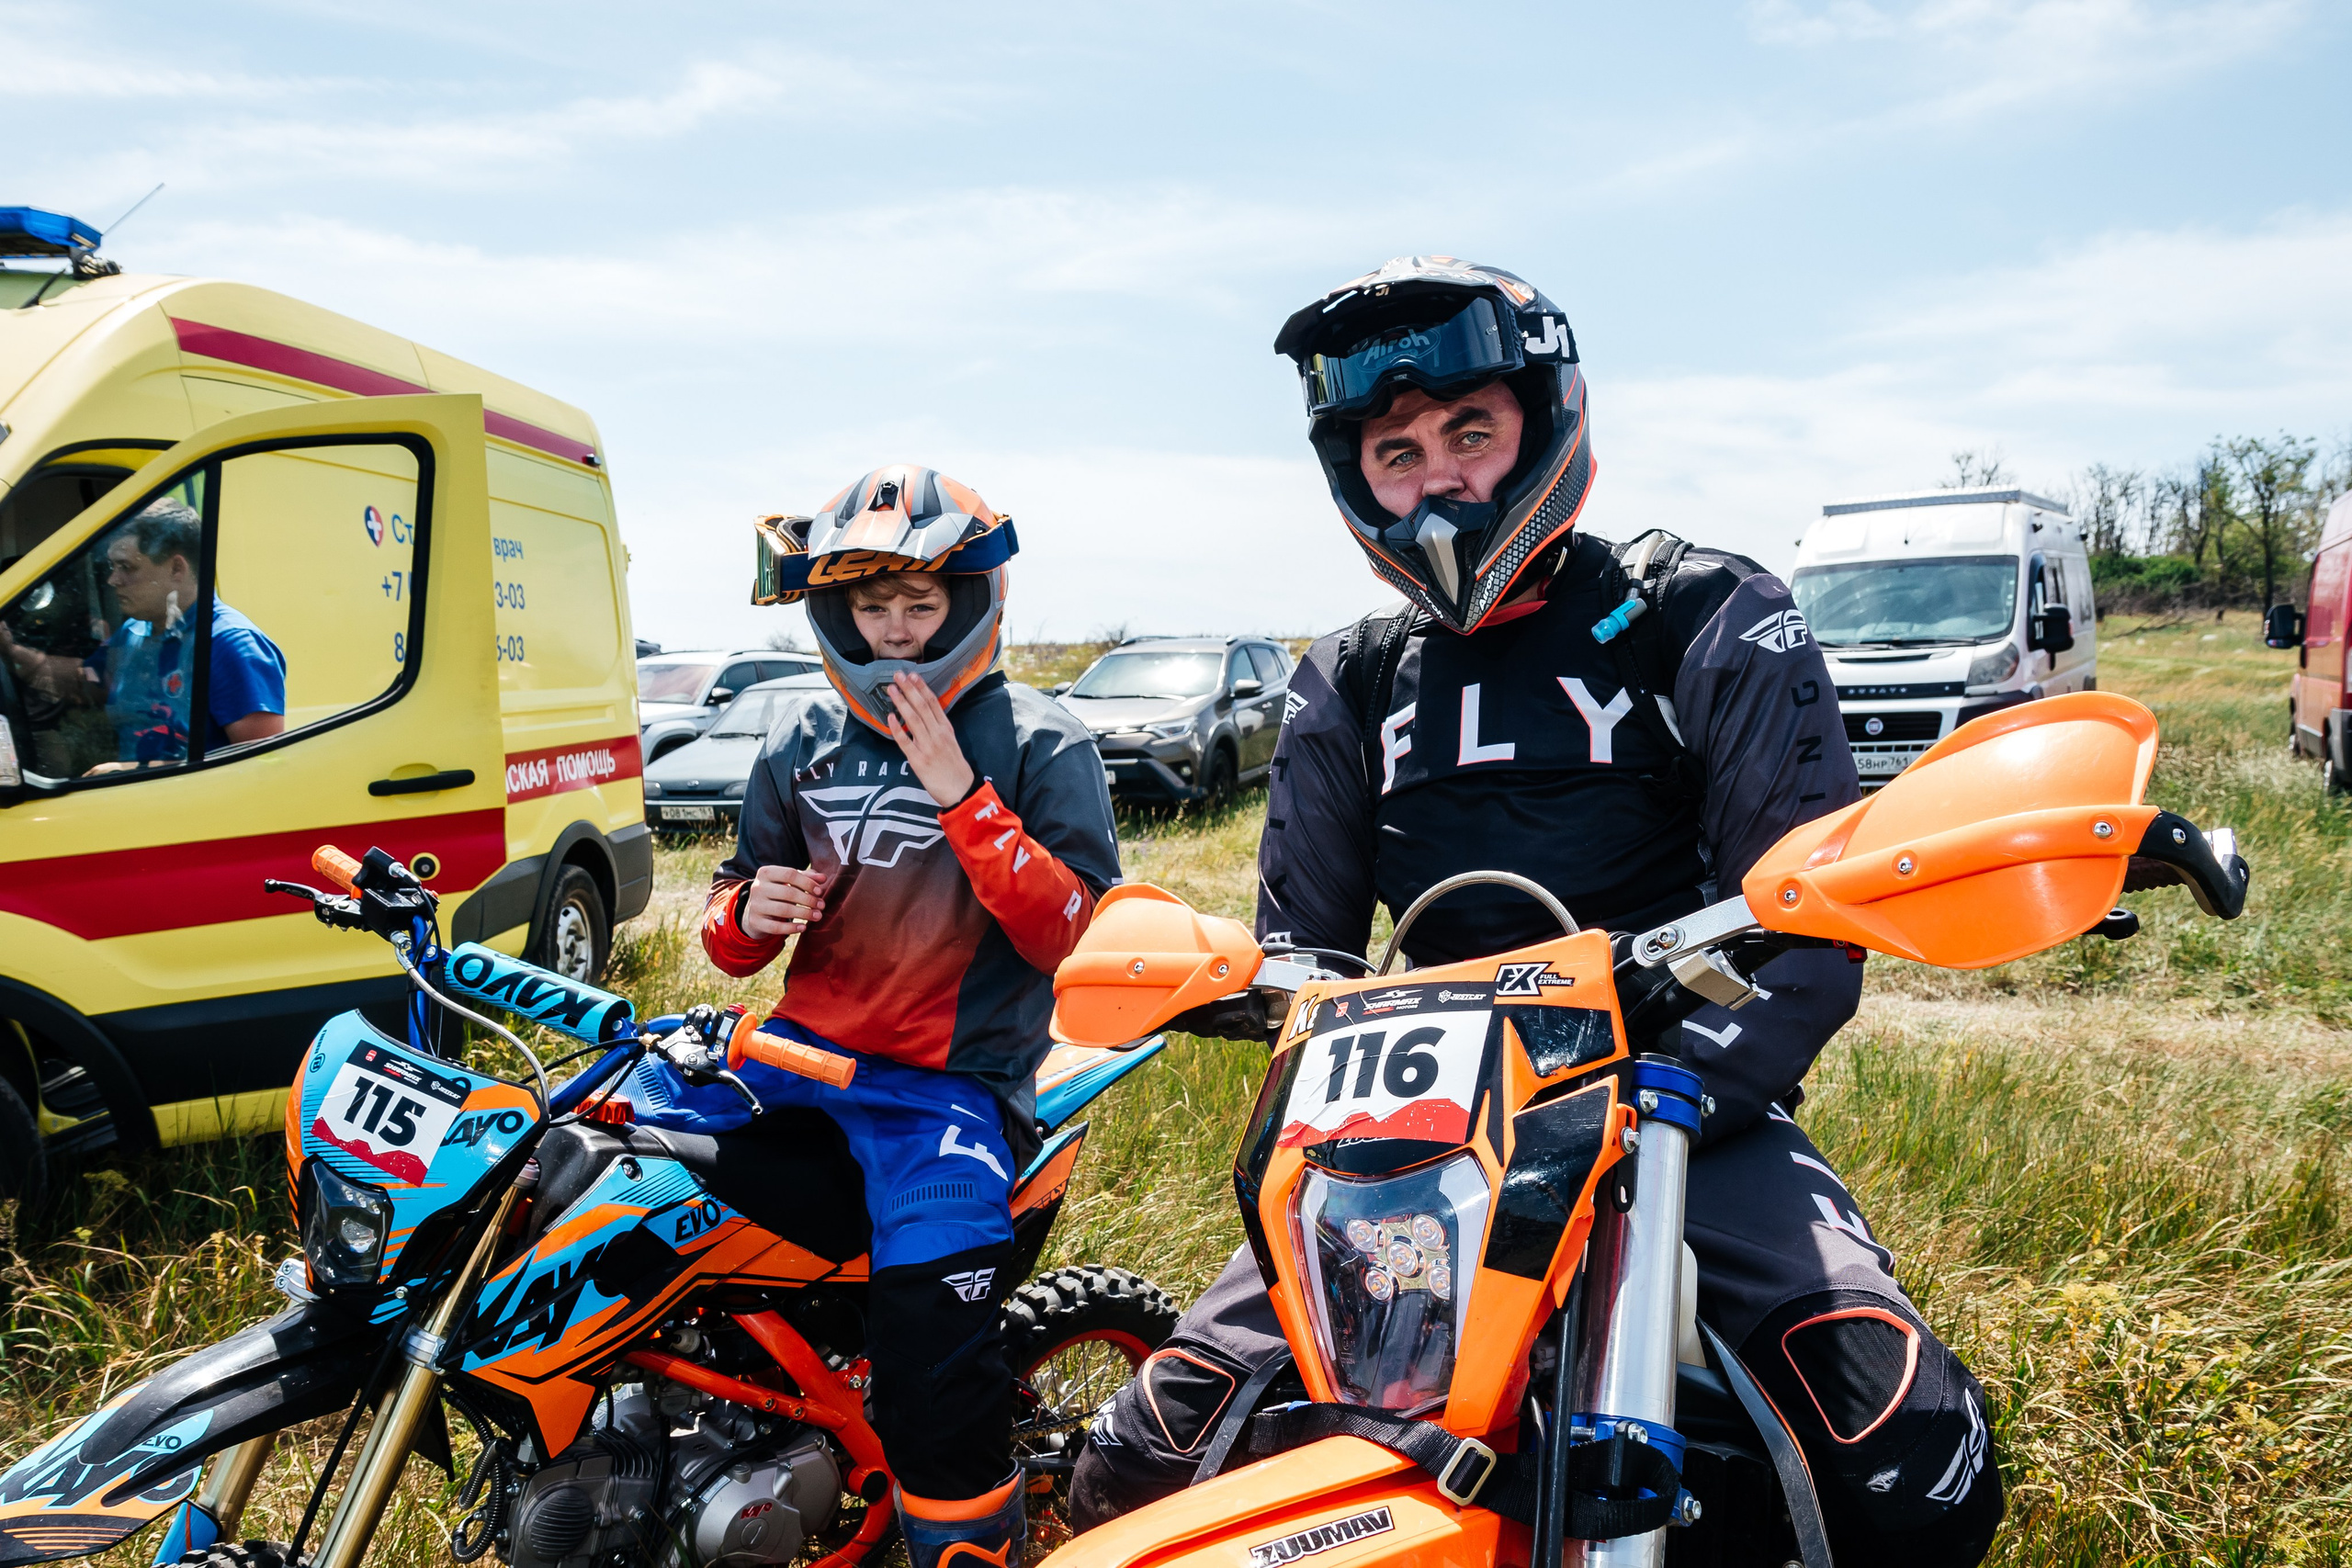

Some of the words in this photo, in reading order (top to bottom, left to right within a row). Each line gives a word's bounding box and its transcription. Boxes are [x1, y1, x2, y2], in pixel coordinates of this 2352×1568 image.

[391, 513, 413, 546] Ст
[492, 536, 525, 562] врач
[494, 581, 526, 610] 3-03
[1419, 589, 1444, 620] Airoh
[1477, 570, 1496, 614] Airoh
[1381, 677, 1634, 795] FLY
[556, 748, 616, 784] ПОМОЩЬ
[795, 762, 834, 782] FLY
[974, 801, 1032, 874] FLY
[453, 953, 607, 1029] KAYO
[1325, 1026, 1447, 1104] 116
[344, 1076, 427, 1147] 115
[674, 1198, 721, 1244] EVO
[141, 1435, 183, 1450] EVO
[1252, 1508, 1392, 1567] ZUUMAV
